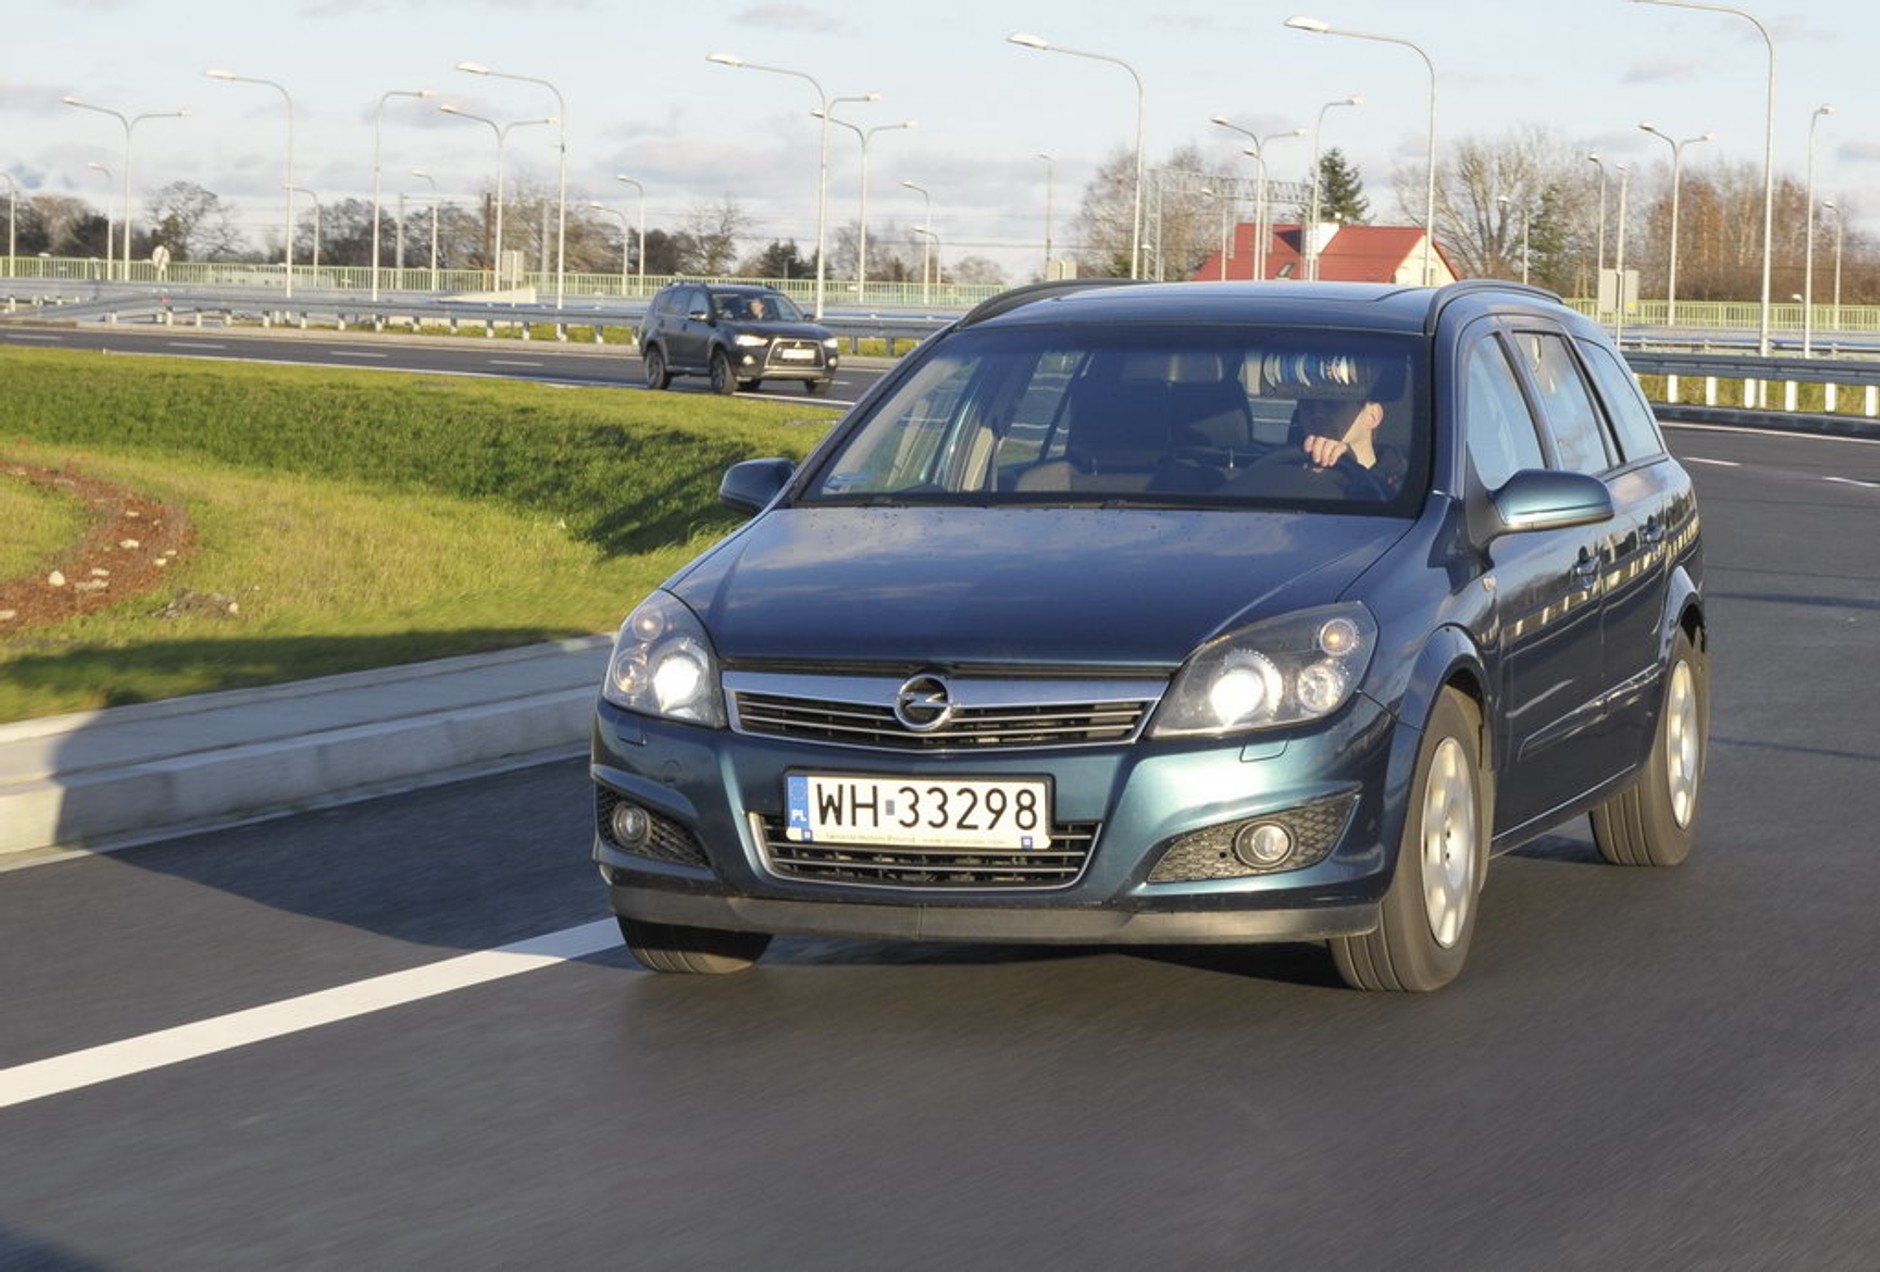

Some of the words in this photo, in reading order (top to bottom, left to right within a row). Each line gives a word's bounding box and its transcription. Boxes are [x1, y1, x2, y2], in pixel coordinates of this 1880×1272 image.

[791, 809, 807, 822] PL
[816, 783, 879, 828] WH
[898, 786, 1038, 831] 33298
